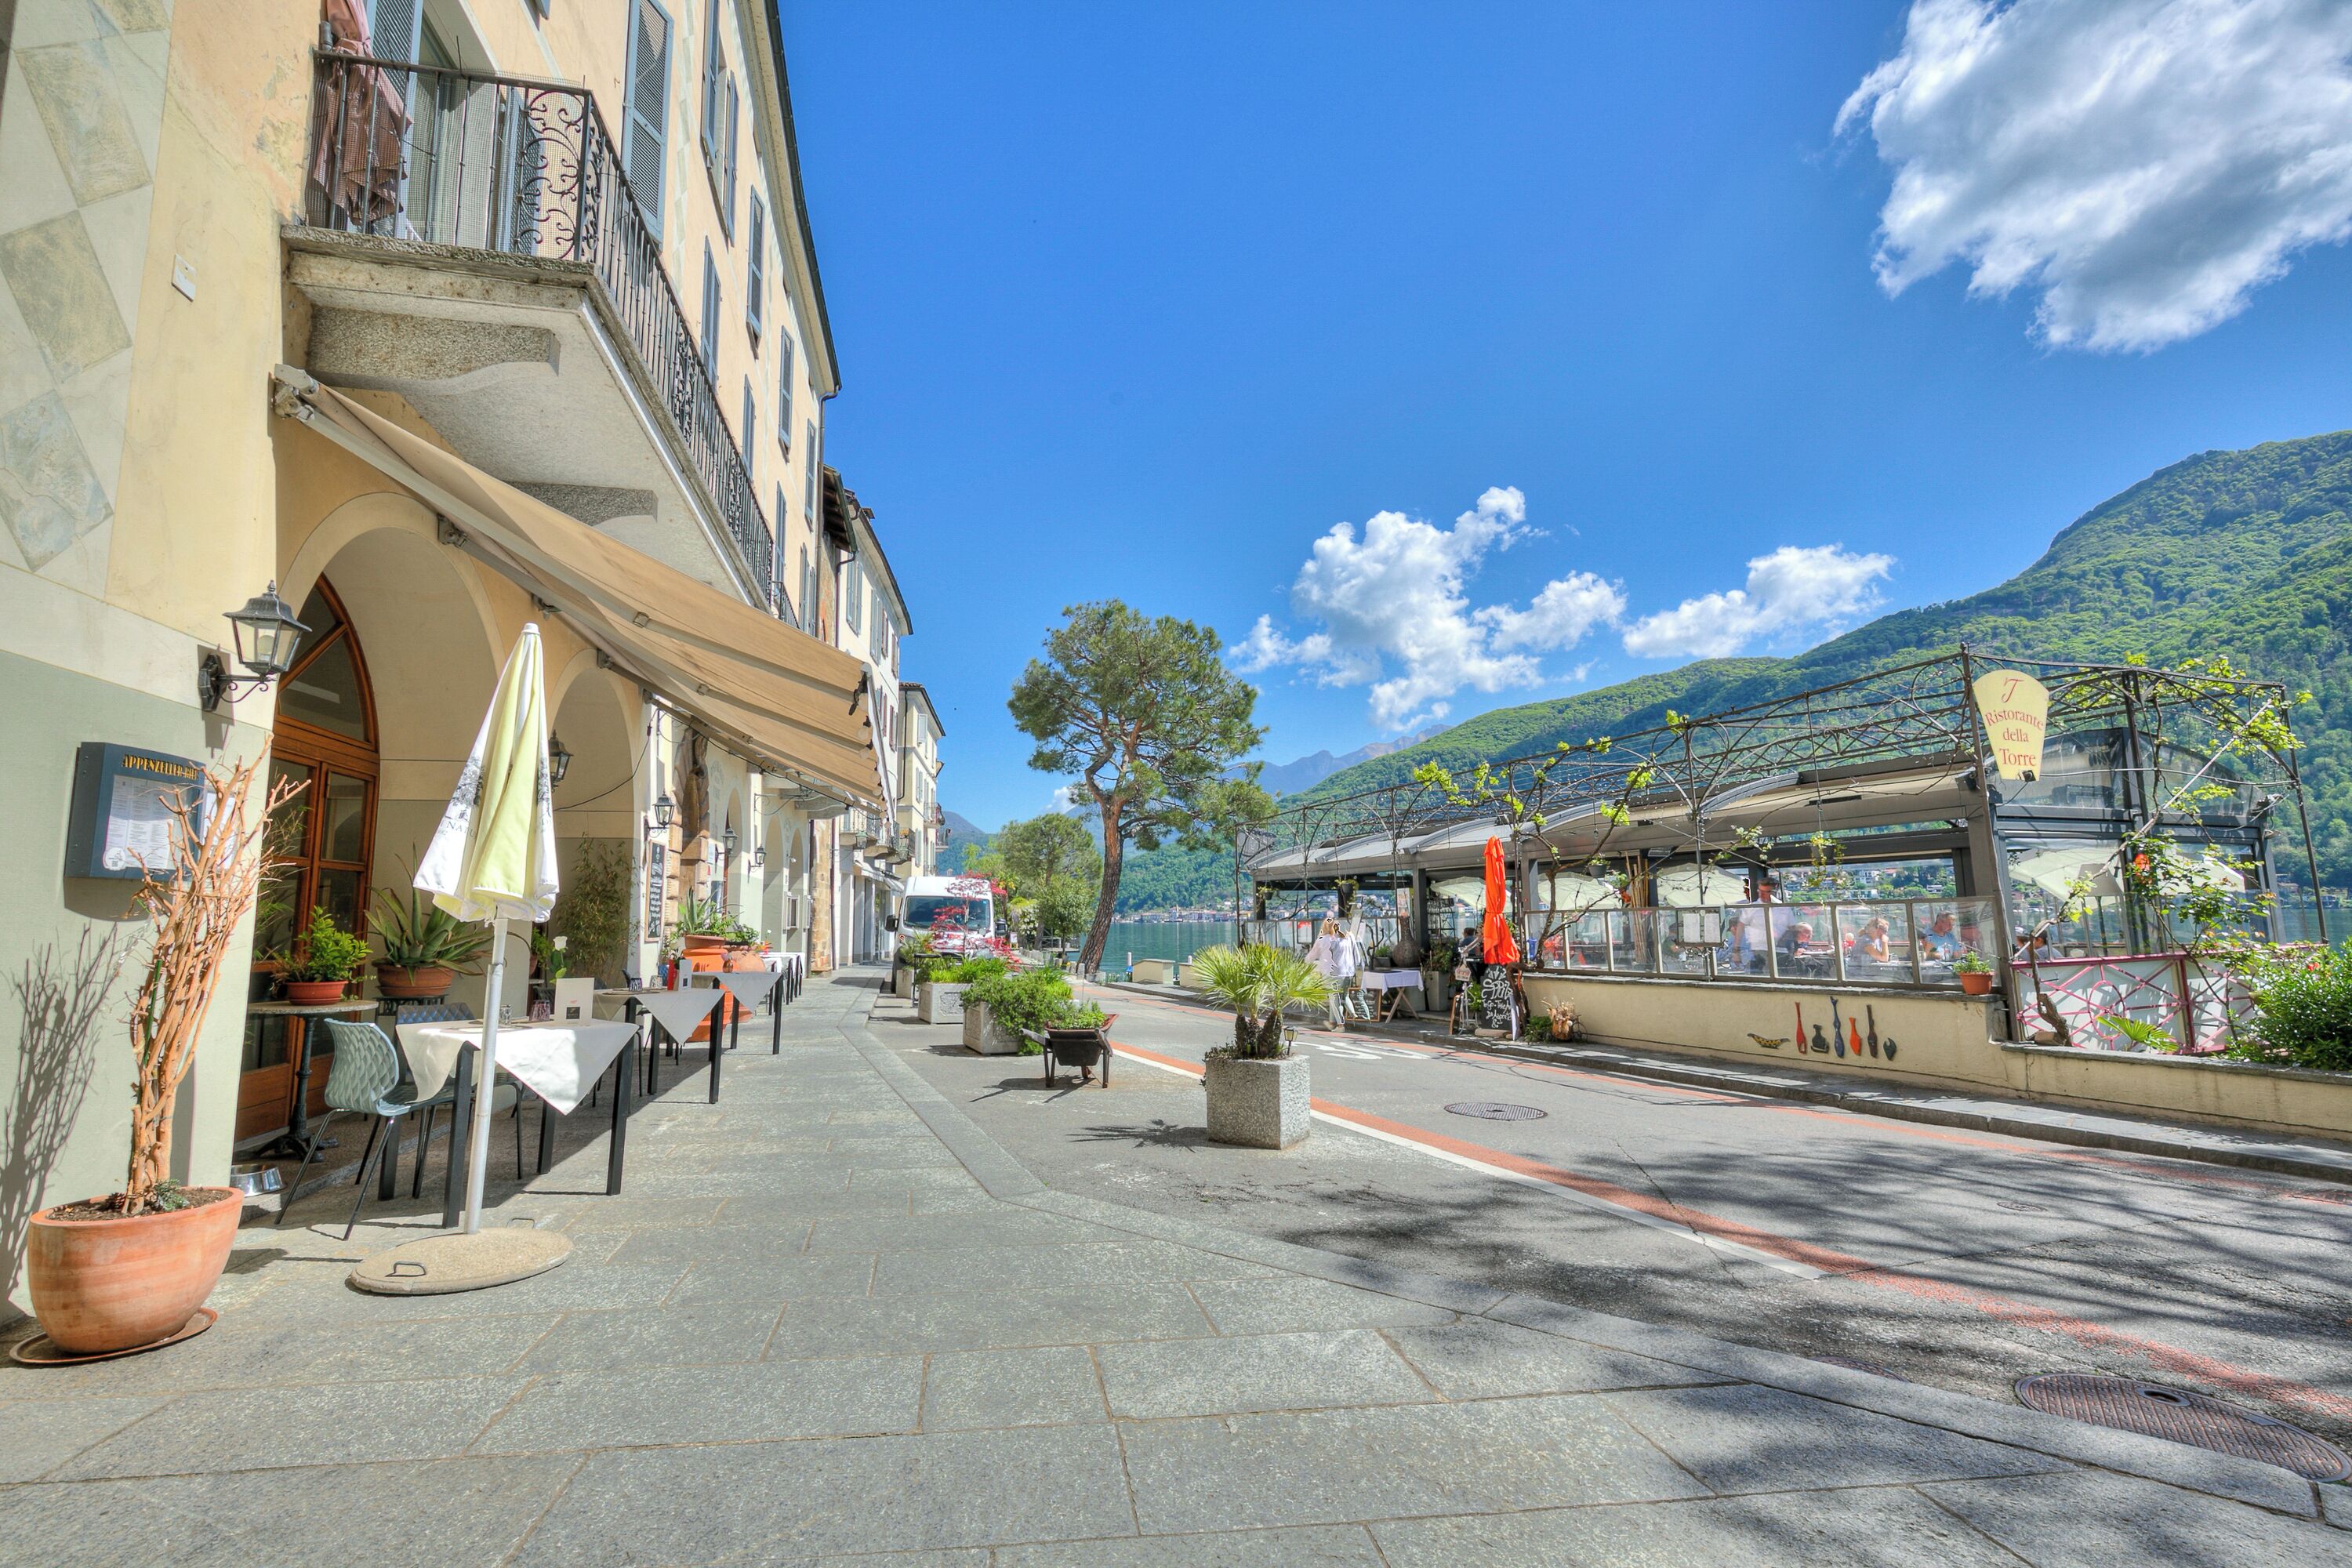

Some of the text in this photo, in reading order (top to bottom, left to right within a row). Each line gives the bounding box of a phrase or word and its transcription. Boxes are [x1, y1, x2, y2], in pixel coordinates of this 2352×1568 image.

[1984, 709, 2044, 731] Ristorante
[2002, 728, 2029, 742] della
[122, 754, 183, 776] APPENZELLER
[1999, 748, 2036, 766] Torre
